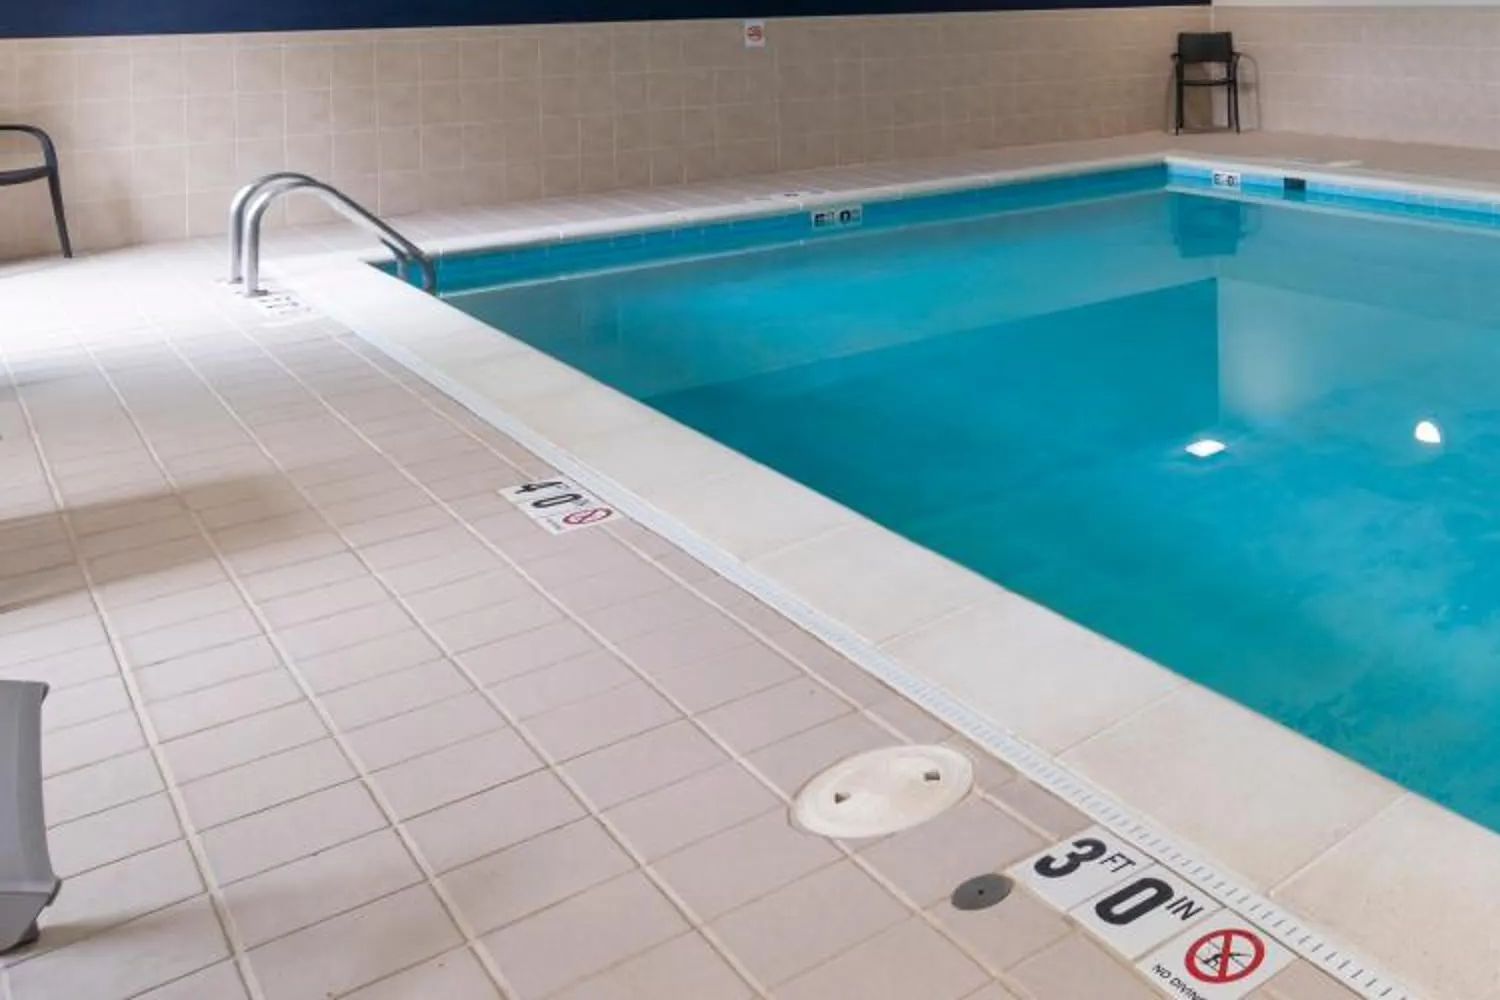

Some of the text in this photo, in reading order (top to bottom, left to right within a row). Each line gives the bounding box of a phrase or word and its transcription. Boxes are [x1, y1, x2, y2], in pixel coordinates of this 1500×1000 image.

[514, 481, 562, 494] 4
[531, 493, 582, 508] 0
[1034, 838, 1203, 925] 3 FT 0 IN
[1152, 964, 1172, 979] NO
